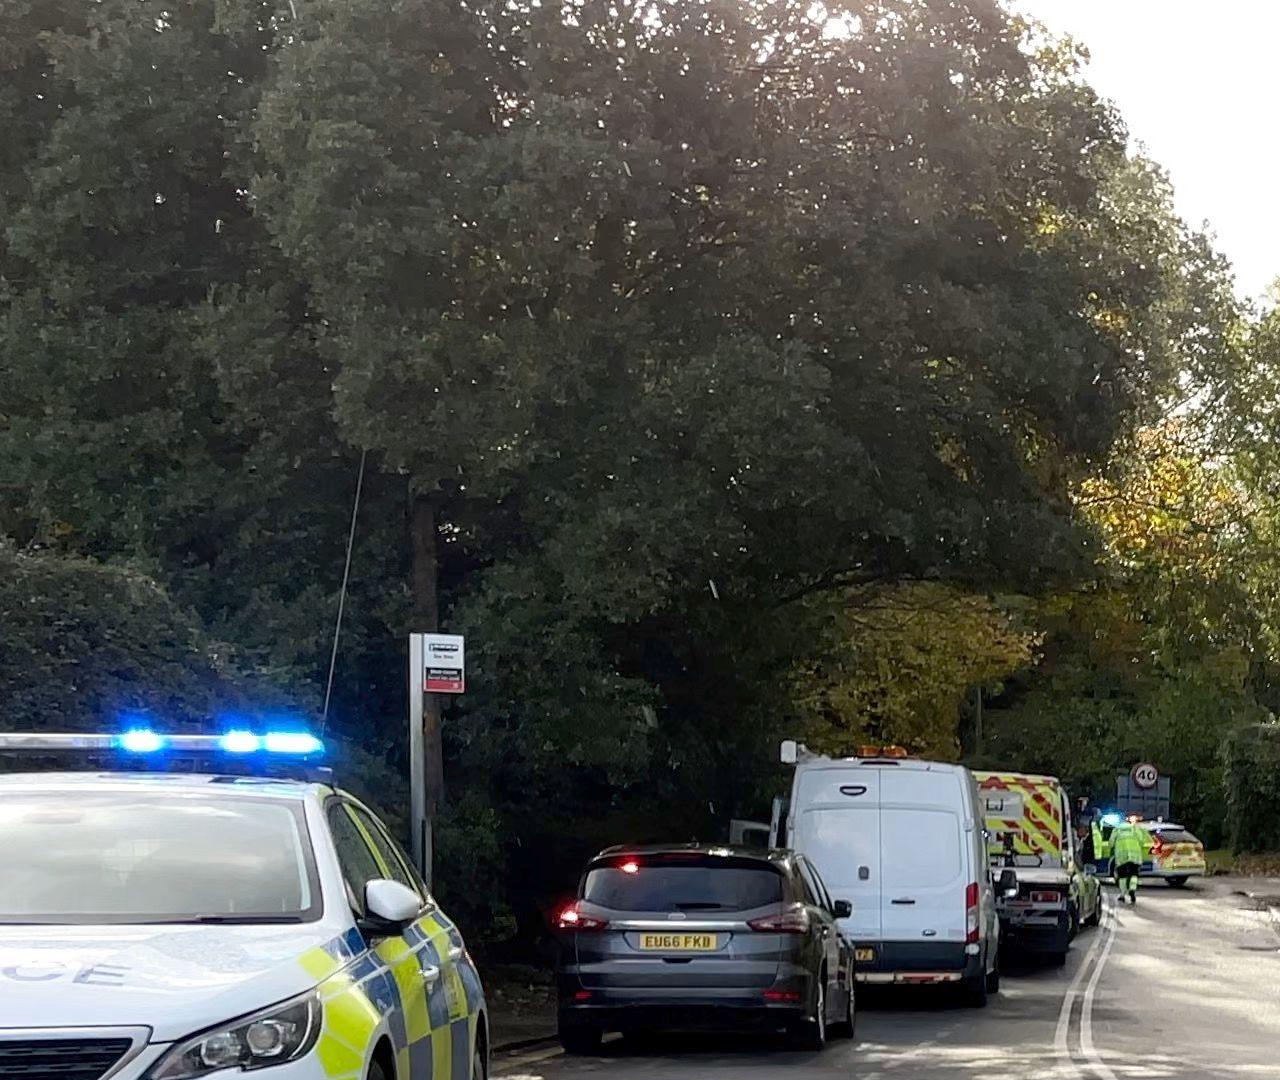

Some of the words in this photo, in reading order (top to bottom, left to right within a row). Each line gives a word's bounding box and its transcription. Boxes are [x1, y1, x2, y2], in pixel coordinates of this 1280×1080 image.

[1138, 769, 1156, 780] 40
[645, 935, 680, 948] EU66
[684, 935, 711, 948] FKD
